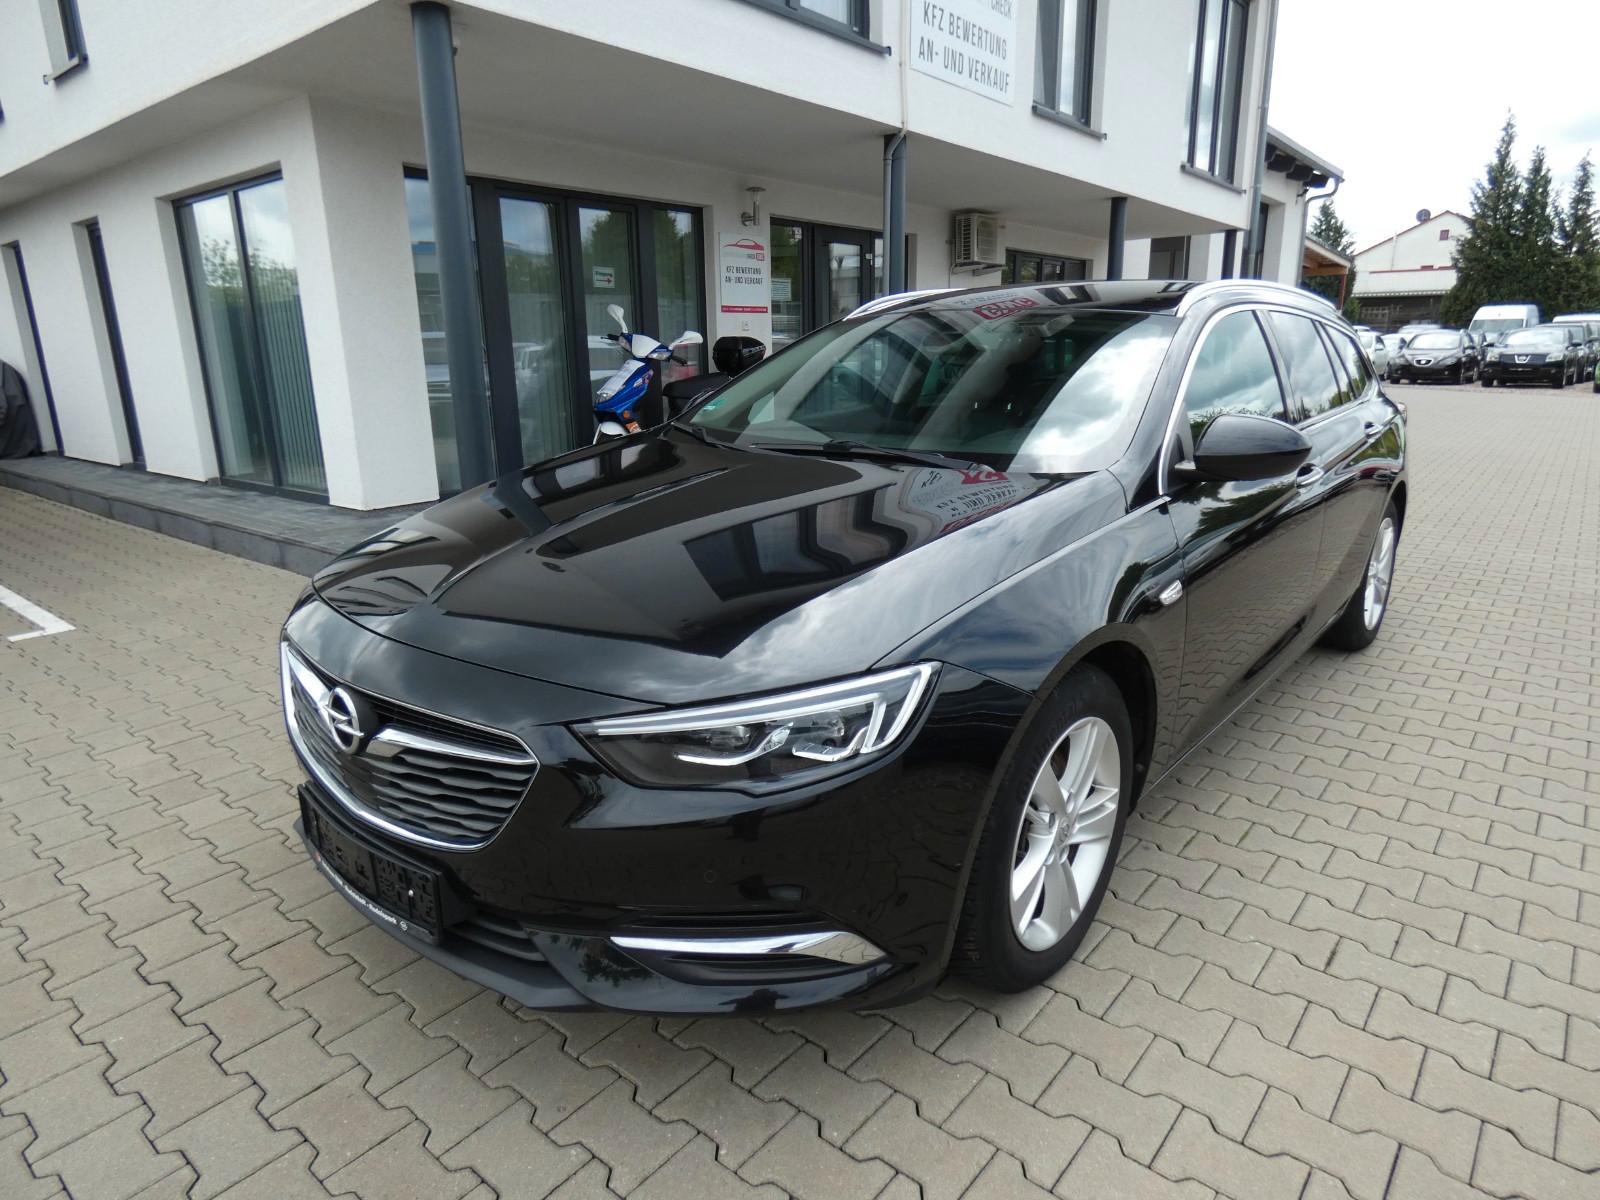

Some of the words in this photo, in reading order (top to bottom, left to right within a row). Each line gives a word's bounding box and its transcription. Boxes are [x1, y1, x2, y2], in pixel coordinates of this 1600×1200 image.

[923, 1, 944, 32] KFZ
[948, 12, 1007, 60] BEWERTUNG
[918, 36, 939, 63] AN-
[943, 46, 964, 75] UND
[968, 57, 1010, 94] VERKAUF
